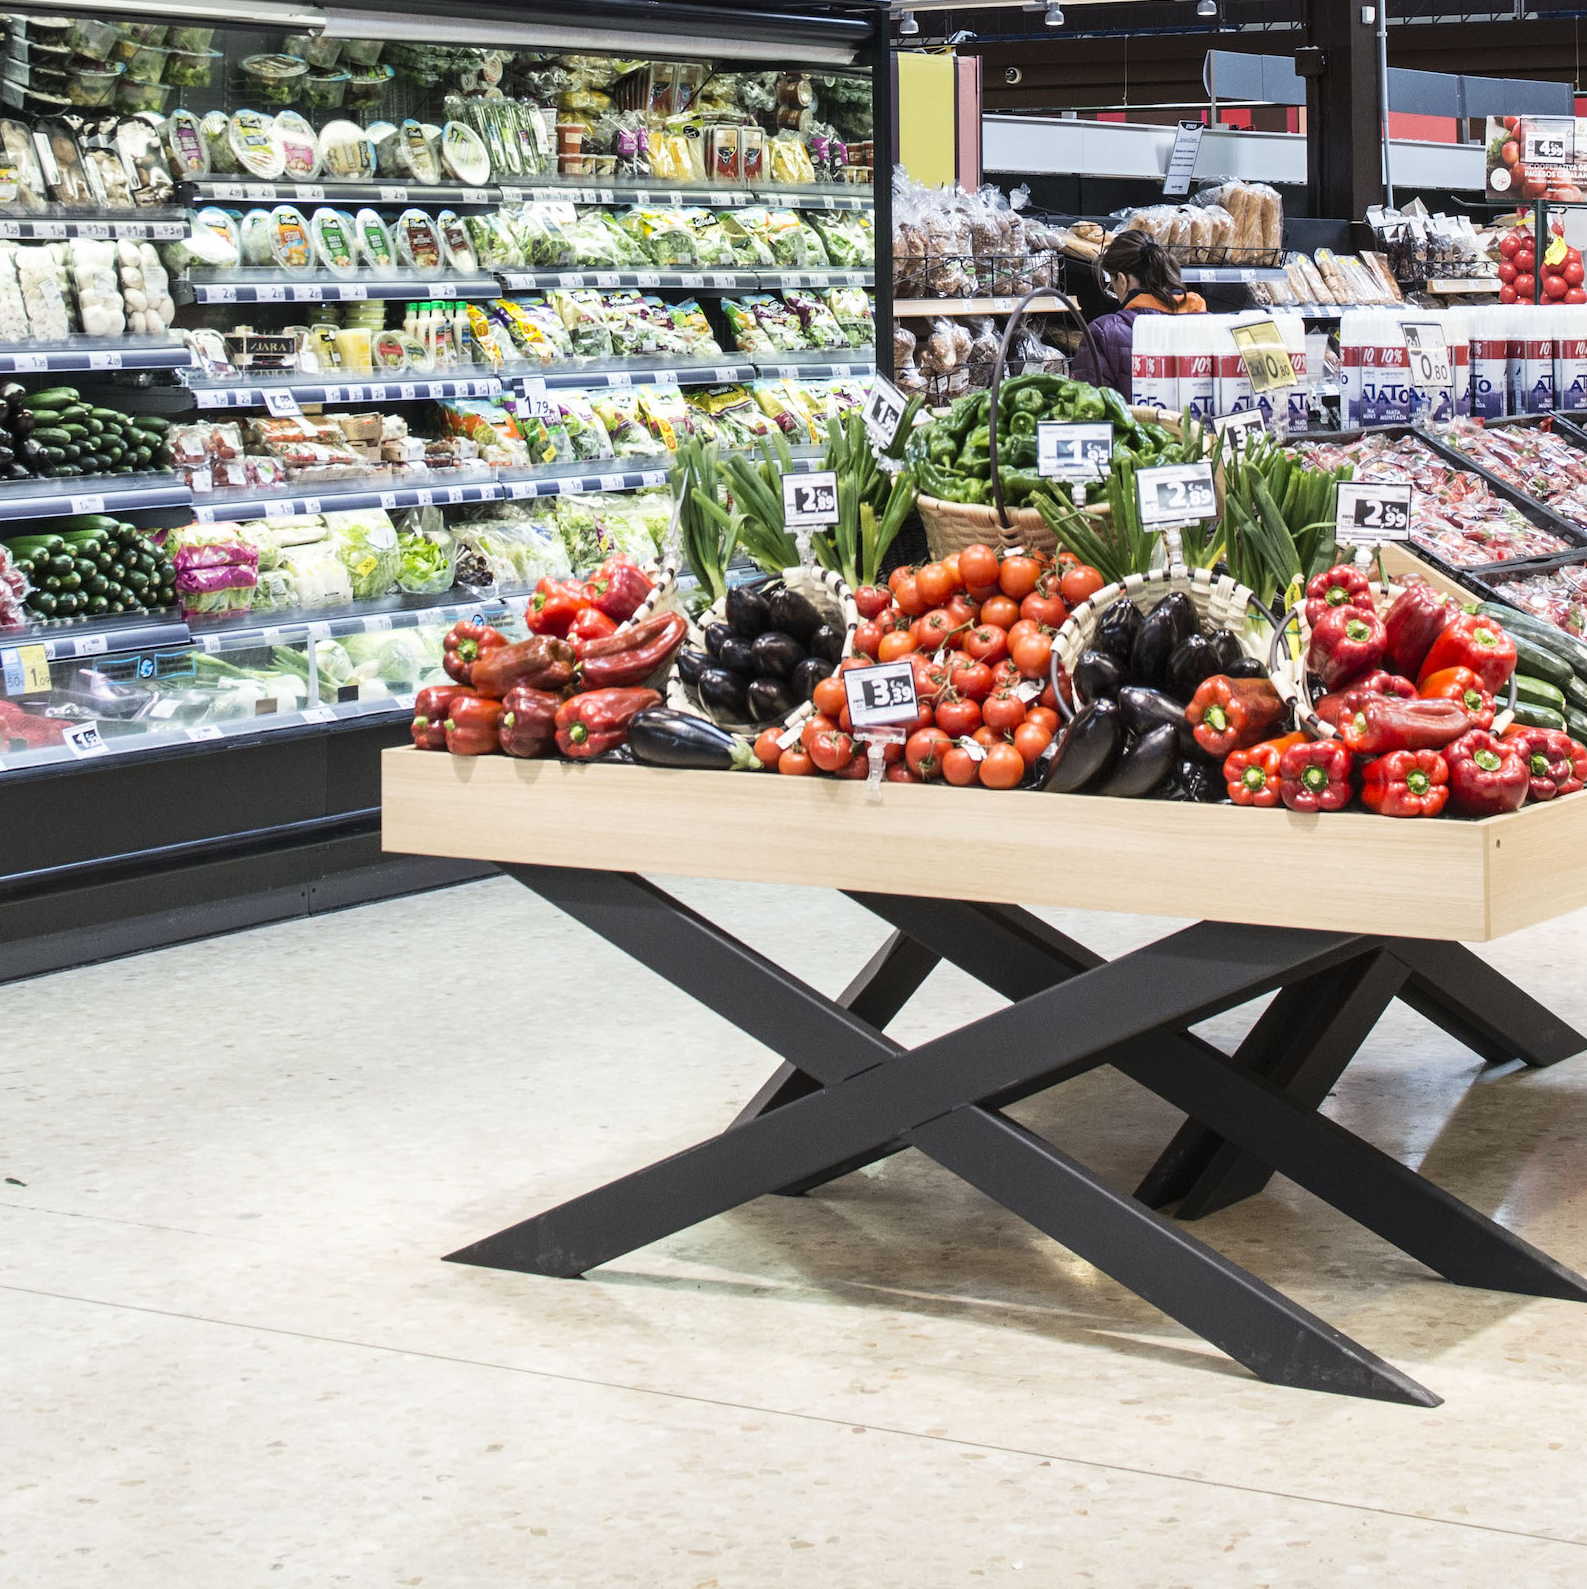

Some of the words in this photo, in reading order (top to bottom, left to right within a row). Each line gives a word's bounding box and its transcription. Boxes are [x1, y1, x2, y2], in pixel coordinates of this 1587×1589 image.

[1524, 171, 1556, 179] PAGESOS
[1265, 354, 1291, 379] 0,80
[1380, 348, 1403, 363] 10%
[1420, 354, 1448, 381] 0,80
[524, 394, 550, 416] 1,79
[1376, 384, 1409, 405] ATO
[1065, 440, 1110, 465] 1,95
[801, 485, 835, 512] 2,89
[1166, 481, 1212, 508] 2,89
[1363, 500, 1407, 527] 2,99
[870, 678, 912, 706] 3,39
